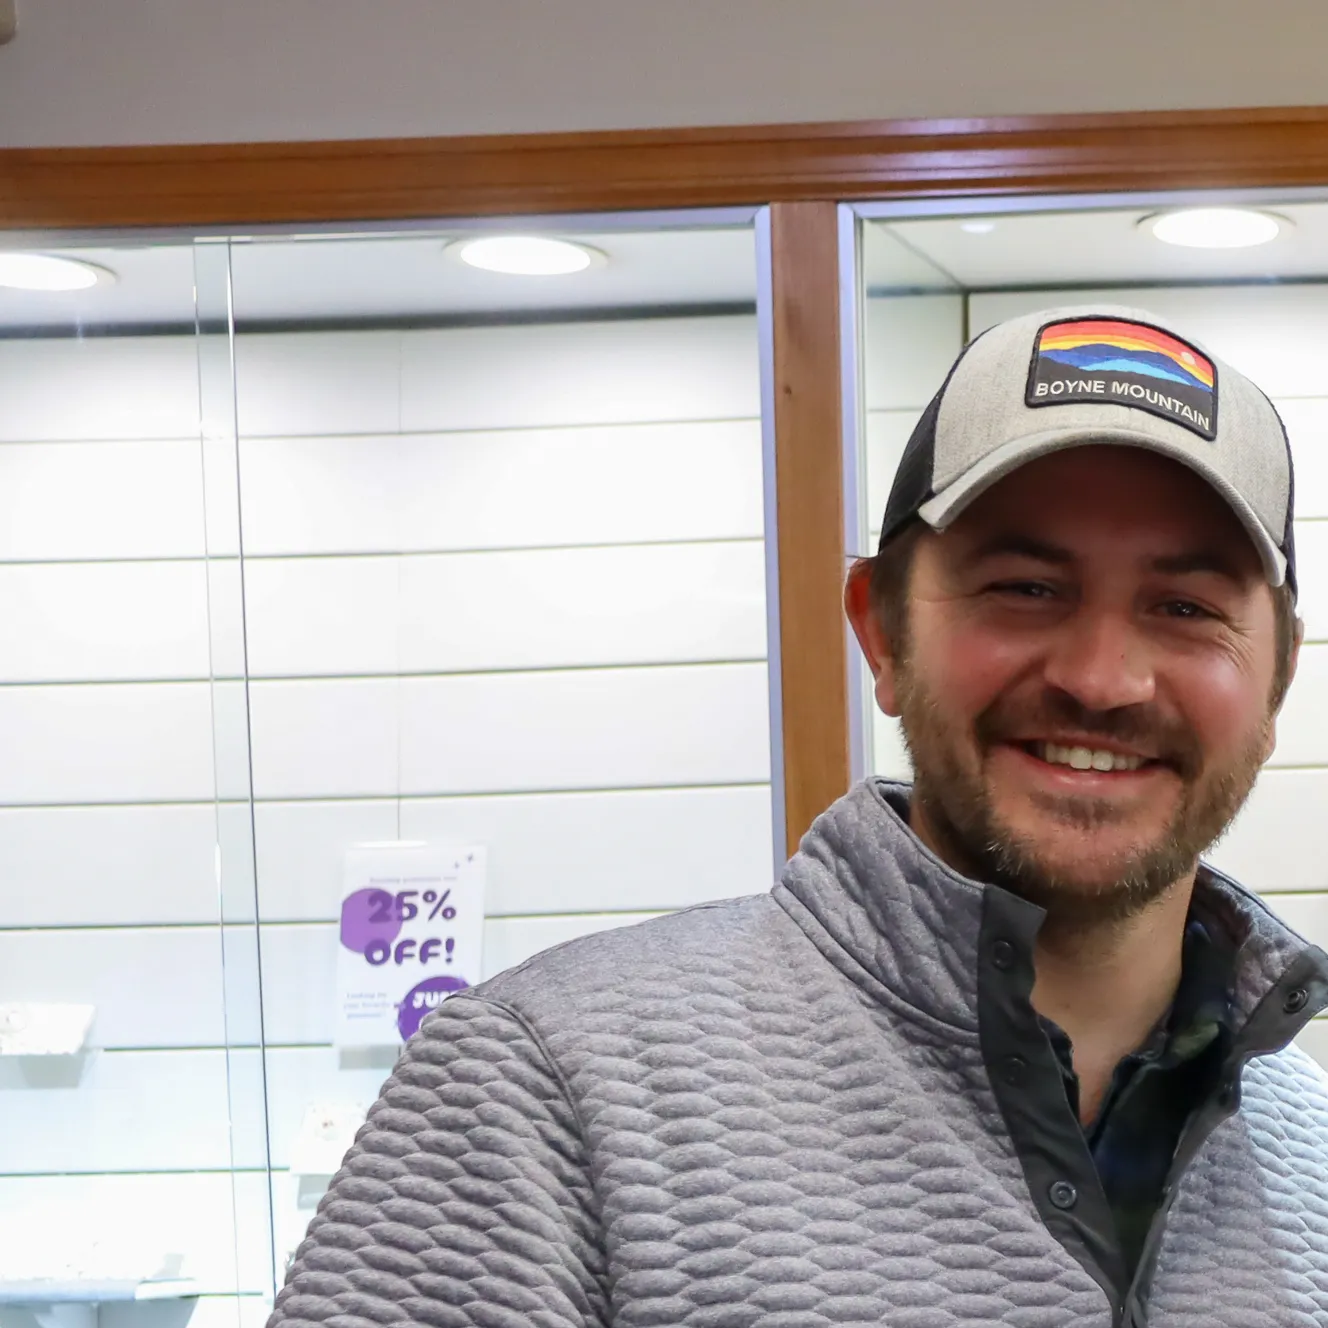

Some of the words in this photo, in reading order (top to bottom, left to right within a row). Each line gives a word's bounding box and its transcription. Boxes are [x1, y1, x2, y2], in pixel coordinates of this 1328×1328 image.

[1034, 379, 1105, 397] BOYNE
[1111, 381, 1210, 431] MOUNTAIN
[367, 888, 457, 924] 25%
[364, 937, 456, 965] OFF!
